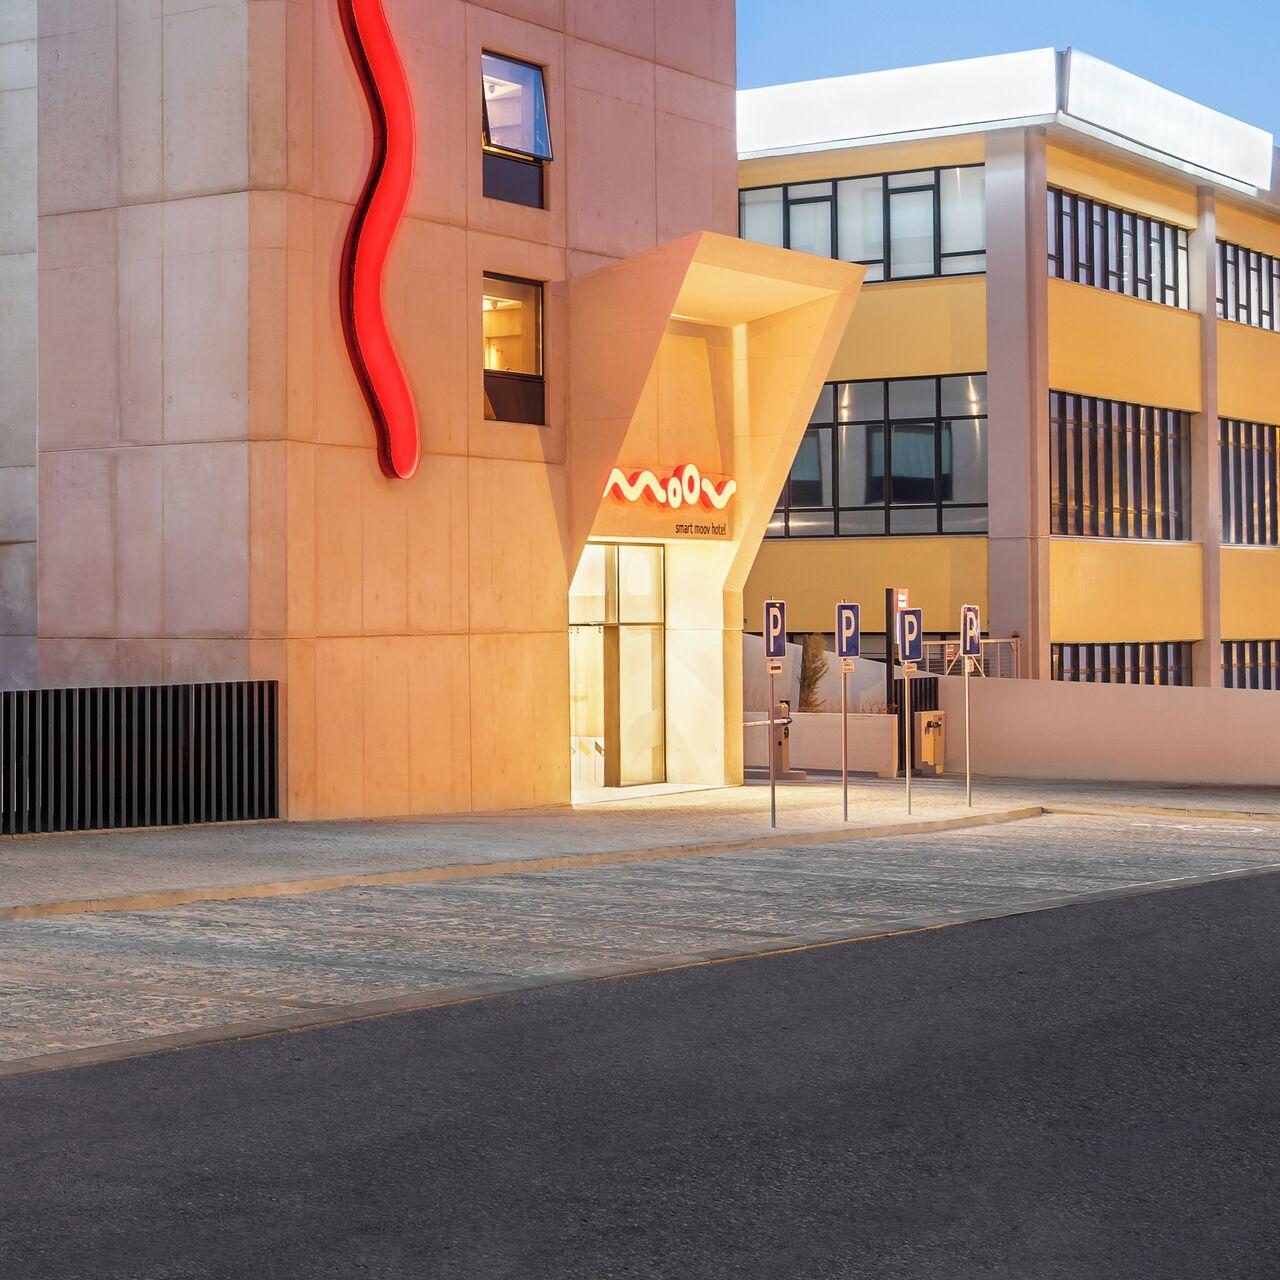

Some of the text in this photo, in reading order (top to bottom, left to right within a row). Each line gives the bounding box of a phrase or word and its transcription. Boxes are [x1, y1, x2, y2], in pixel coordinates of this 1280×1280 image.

[675, 522, 727, 536] smart moov hotel
[769, 607, 782, 653] P
[841, 609, 855, 653] P
[904, 614, 918, 656] P
